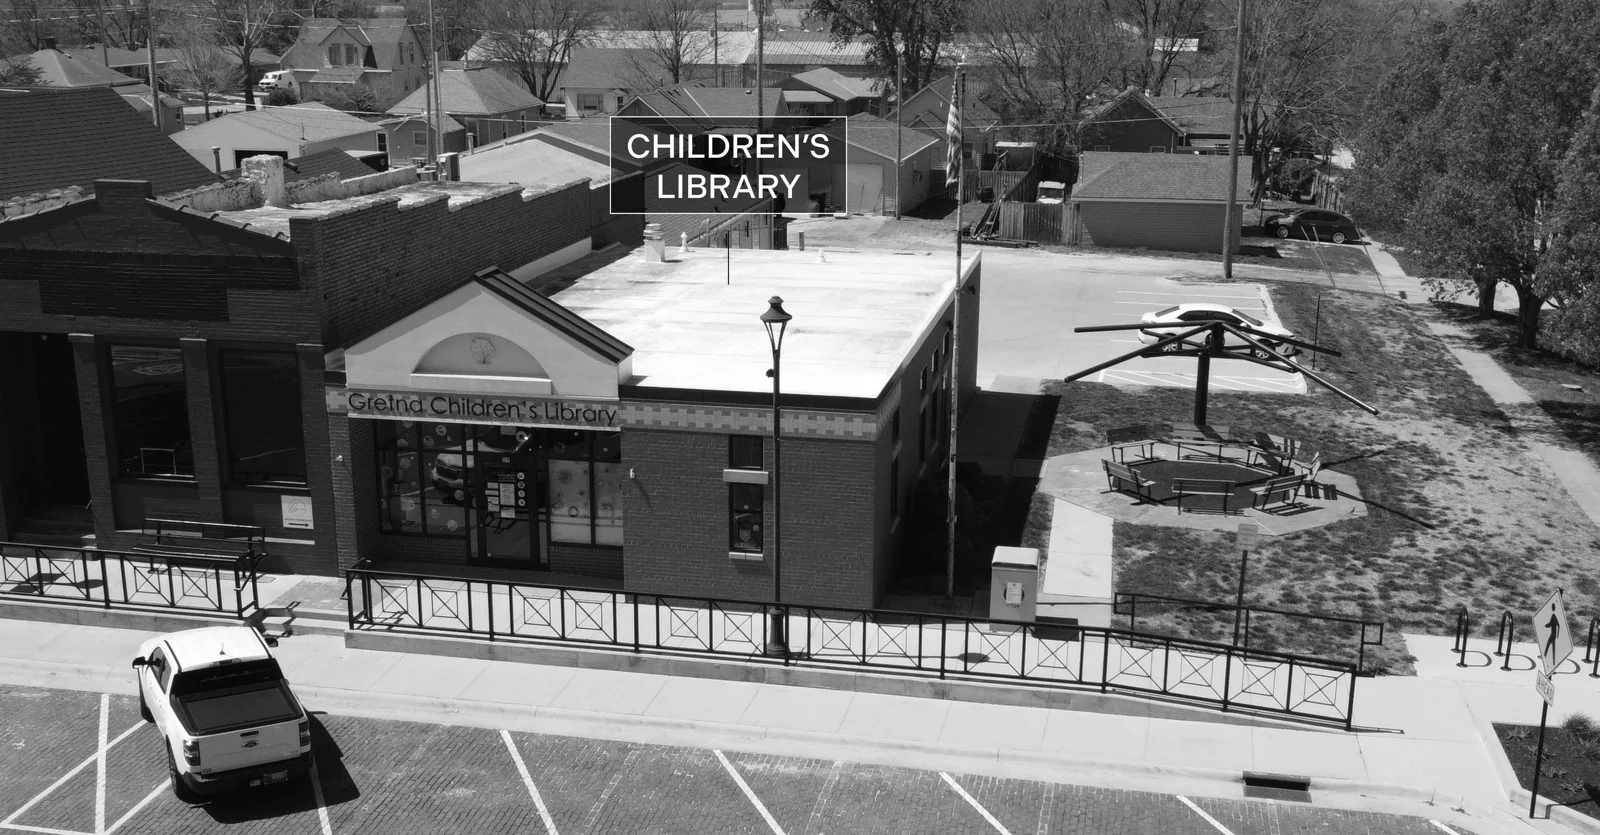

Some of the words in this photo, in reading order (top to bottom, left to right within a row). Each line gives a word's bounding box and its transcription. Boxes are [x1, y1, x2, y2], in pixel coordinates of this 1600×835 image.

[348, 393, 423, 413] Gretna
[430, 396, 537, 419] Children's
[545, 401, 617, 426] Library
